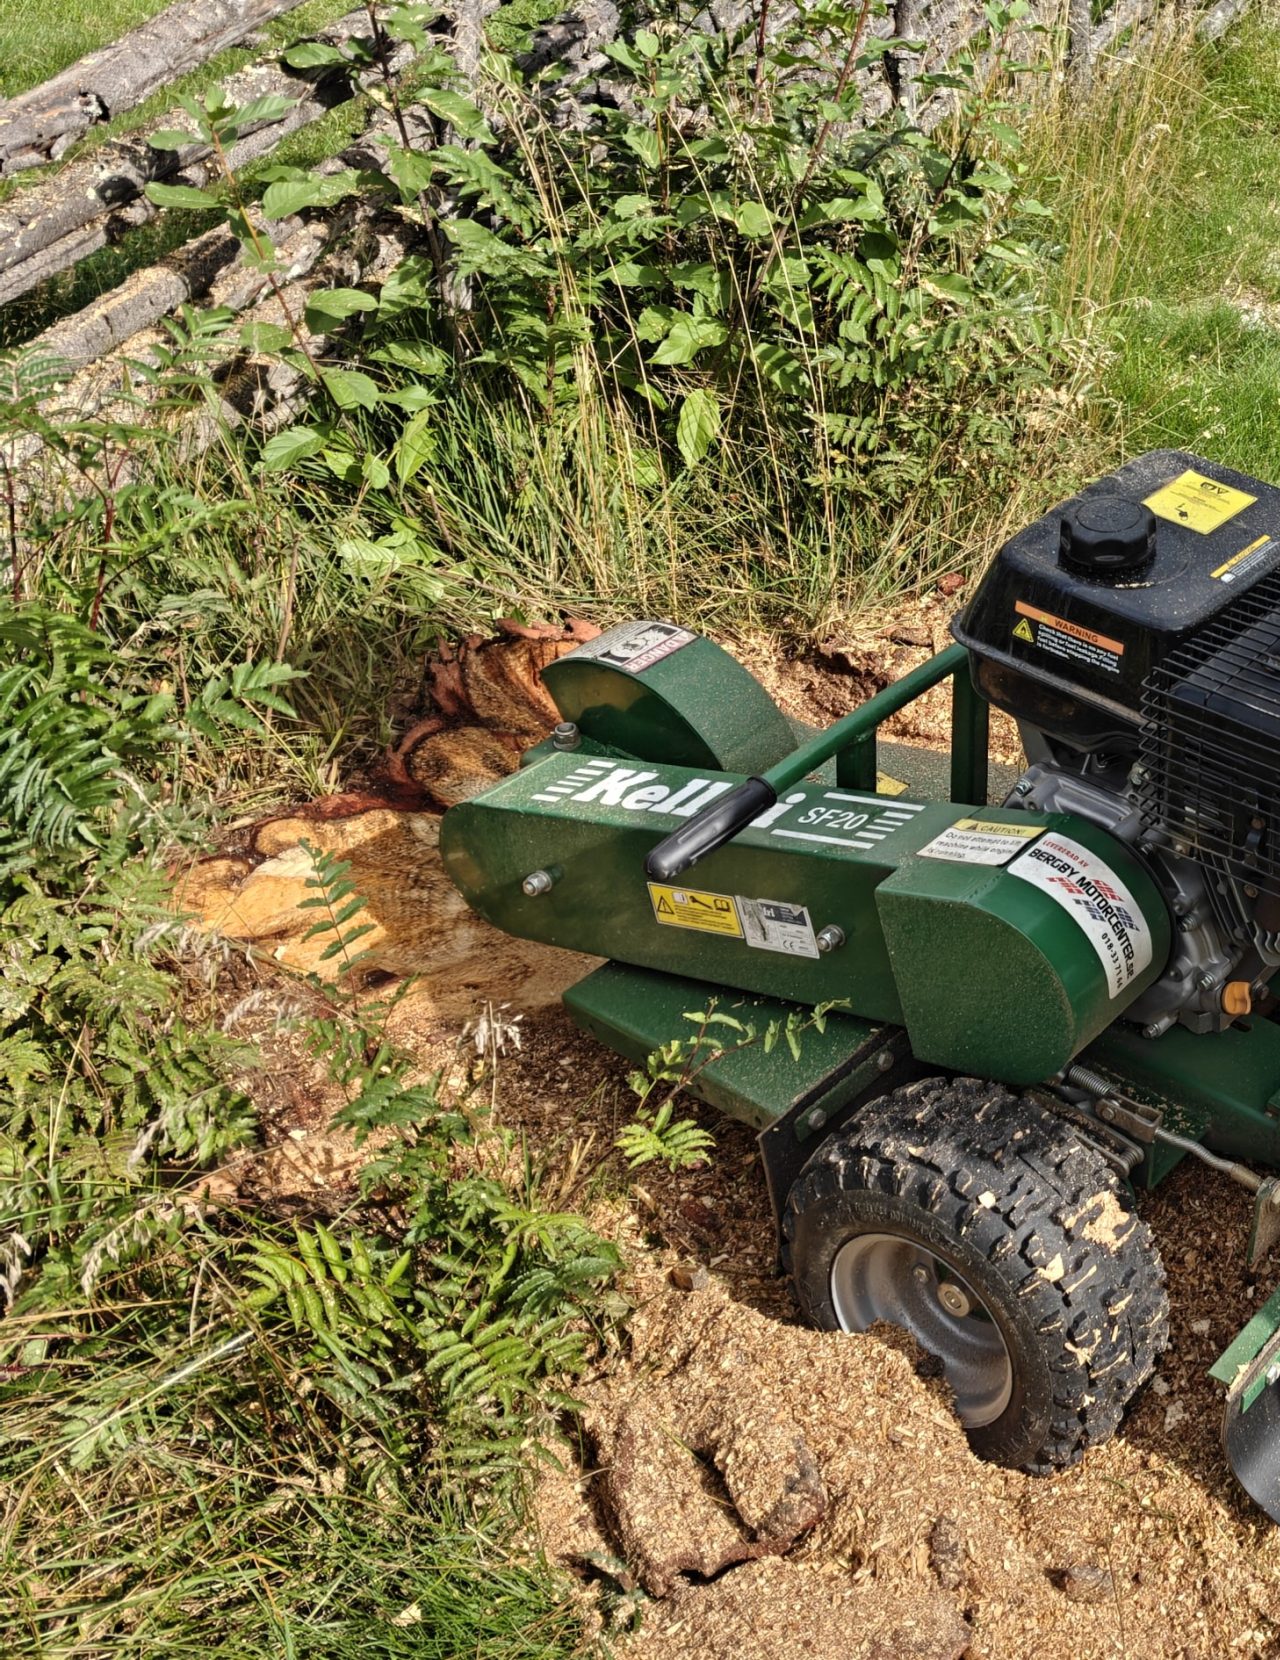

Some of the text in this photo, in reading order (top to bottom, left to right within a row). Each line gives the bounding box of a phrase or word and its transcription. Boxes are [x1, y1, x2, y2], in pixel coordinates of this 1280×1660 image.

[1054, 619, 1099, 643] WARNING
[624, 639, 682, 674] DANGER
[570, 768, 871, 831] Kelli SF20
[1028, 847, 1081, 878] BERGBY
[1042, 840, 1080, 861] LEVERERAD
[1101, 932, 1120, 964] 018-33
